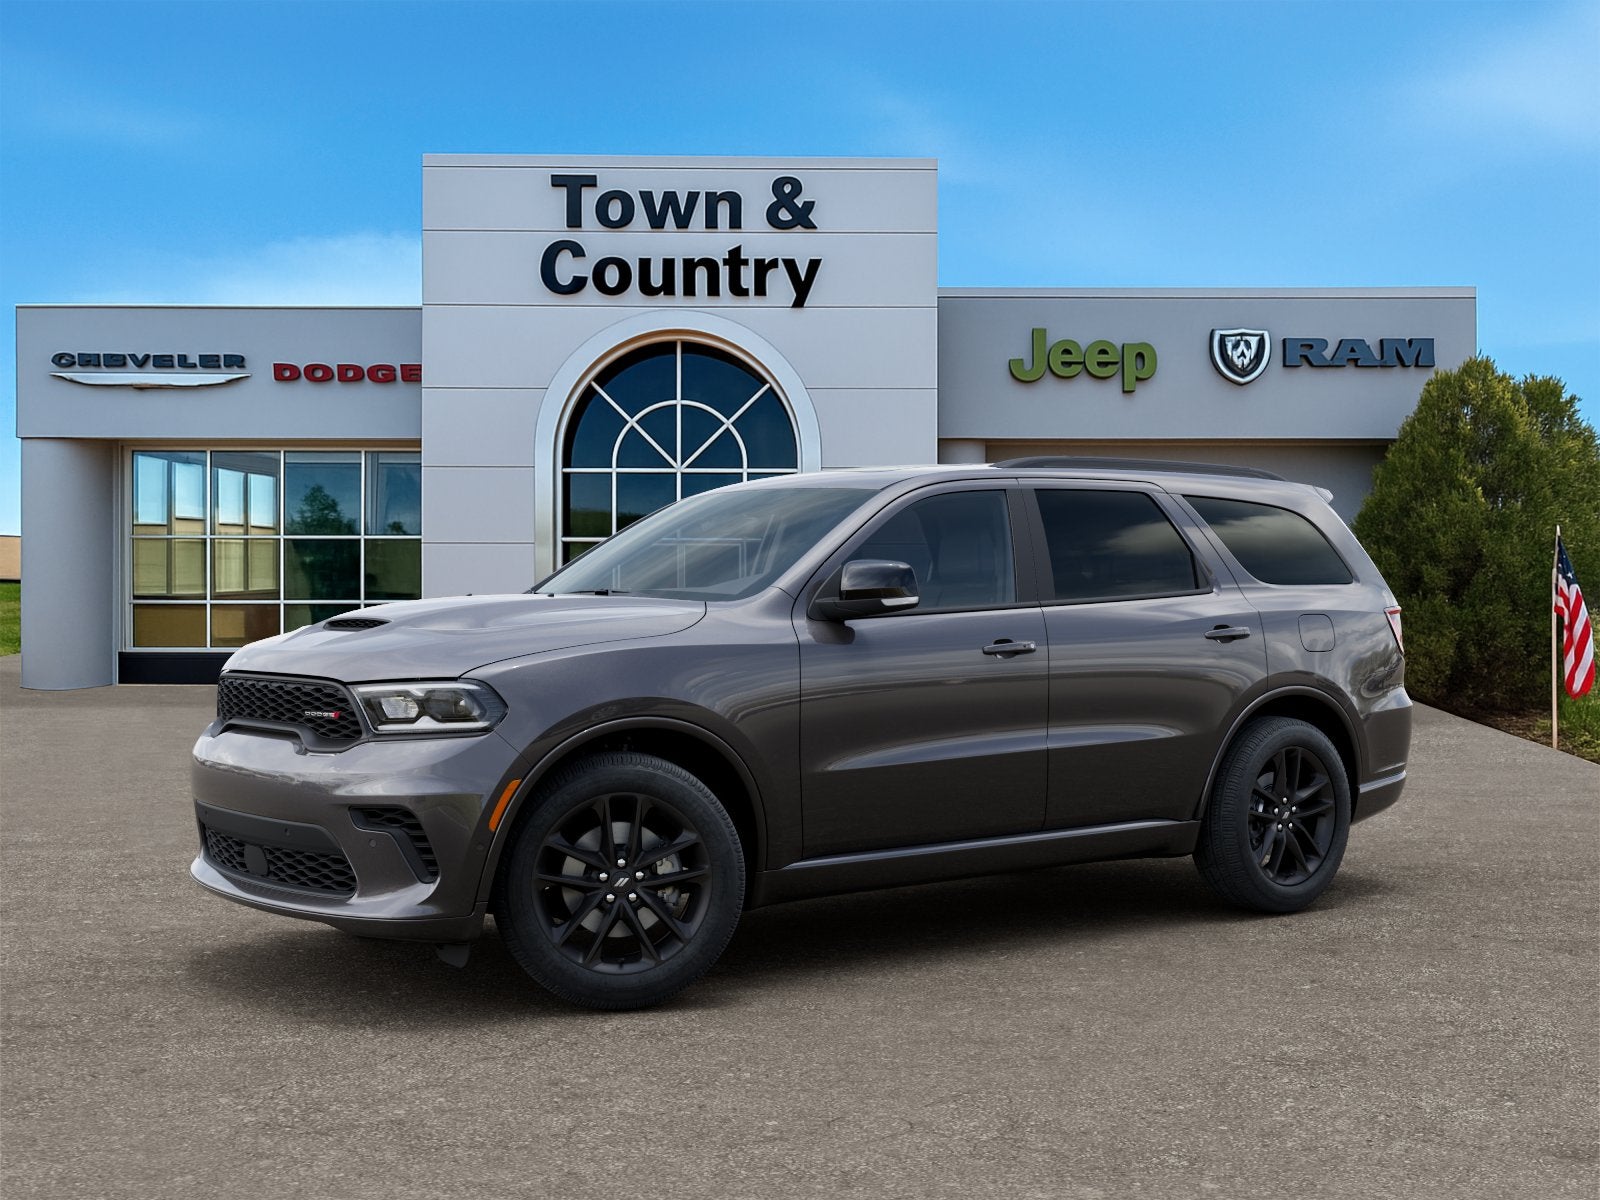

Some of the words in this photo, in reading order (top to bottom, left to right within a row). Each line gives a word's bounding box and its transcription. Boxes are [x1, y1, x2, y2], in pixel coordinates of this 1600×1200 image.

[550, 174, 742, 229] Town
[766, 176, 818, 230] &
[540, 239, 822, 308] Country
[273, 363, 422, 383] DODGE
[1009, 328, 1157, 393] Jeep
[1283, 338, 1436, 368] RAM
